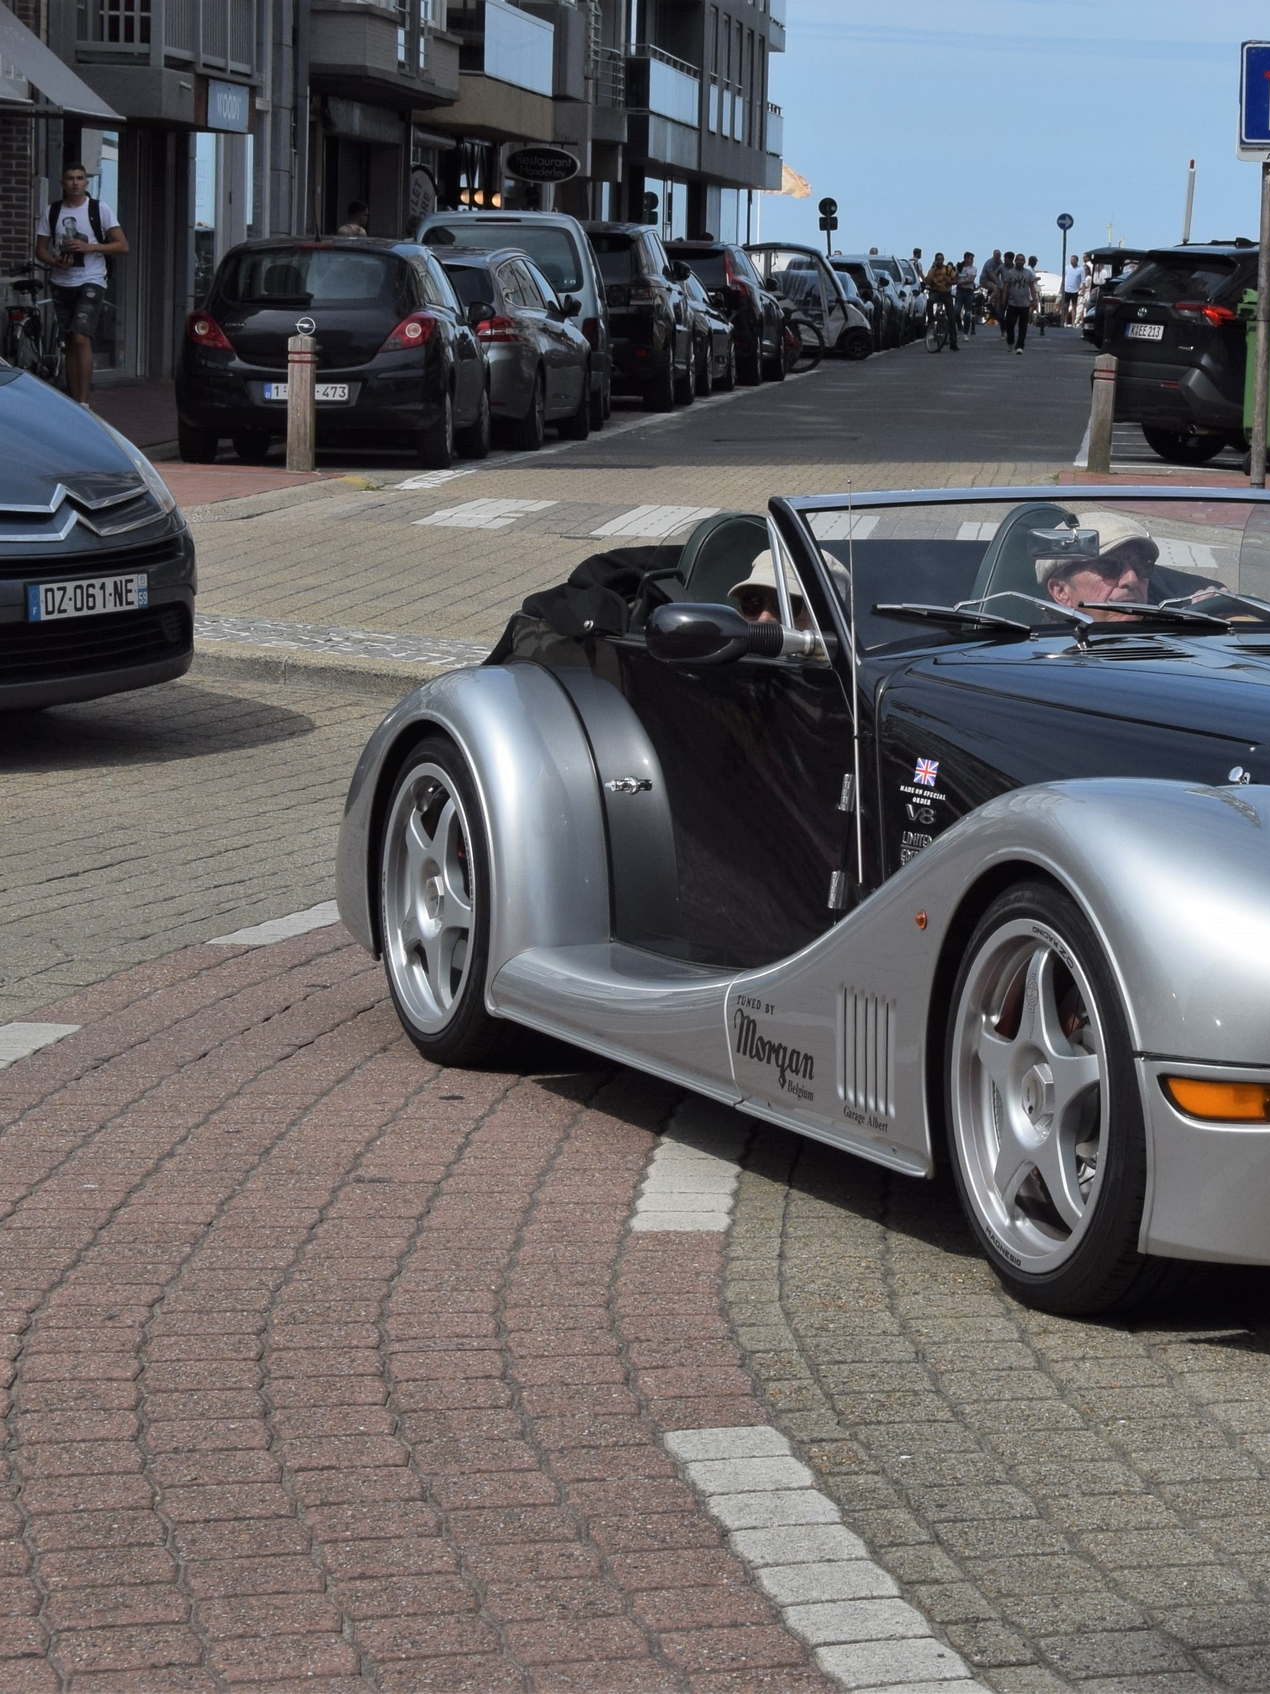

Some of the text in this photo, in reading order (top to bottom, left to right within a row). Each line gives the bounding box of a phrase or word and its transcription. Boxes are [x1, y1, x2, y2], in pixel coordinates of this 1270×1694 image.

[516, 153, 572, 167] Restaurant
[44, 579, 135, 616] DZ-061-NE
[138, 591, 148, 605] 59
[32, 607, 37, 615] F
[900, 785, 946, 801] MADE ON SPECIAL
[912, 796, 931, 806] ORDER
[905, 803, 936, 825] V8
[1032, 926, 1075, 970] OZ RACING
[736, 995, 775, 1015] TUNED BY
[734, 1008, 814, 1090] Morgan
[788, 1080, 814, 1102] Belgium
[843, 1105, 888, 1133] Garage Albert
[985, 1226, 1022, 1267] MAGNESIO
